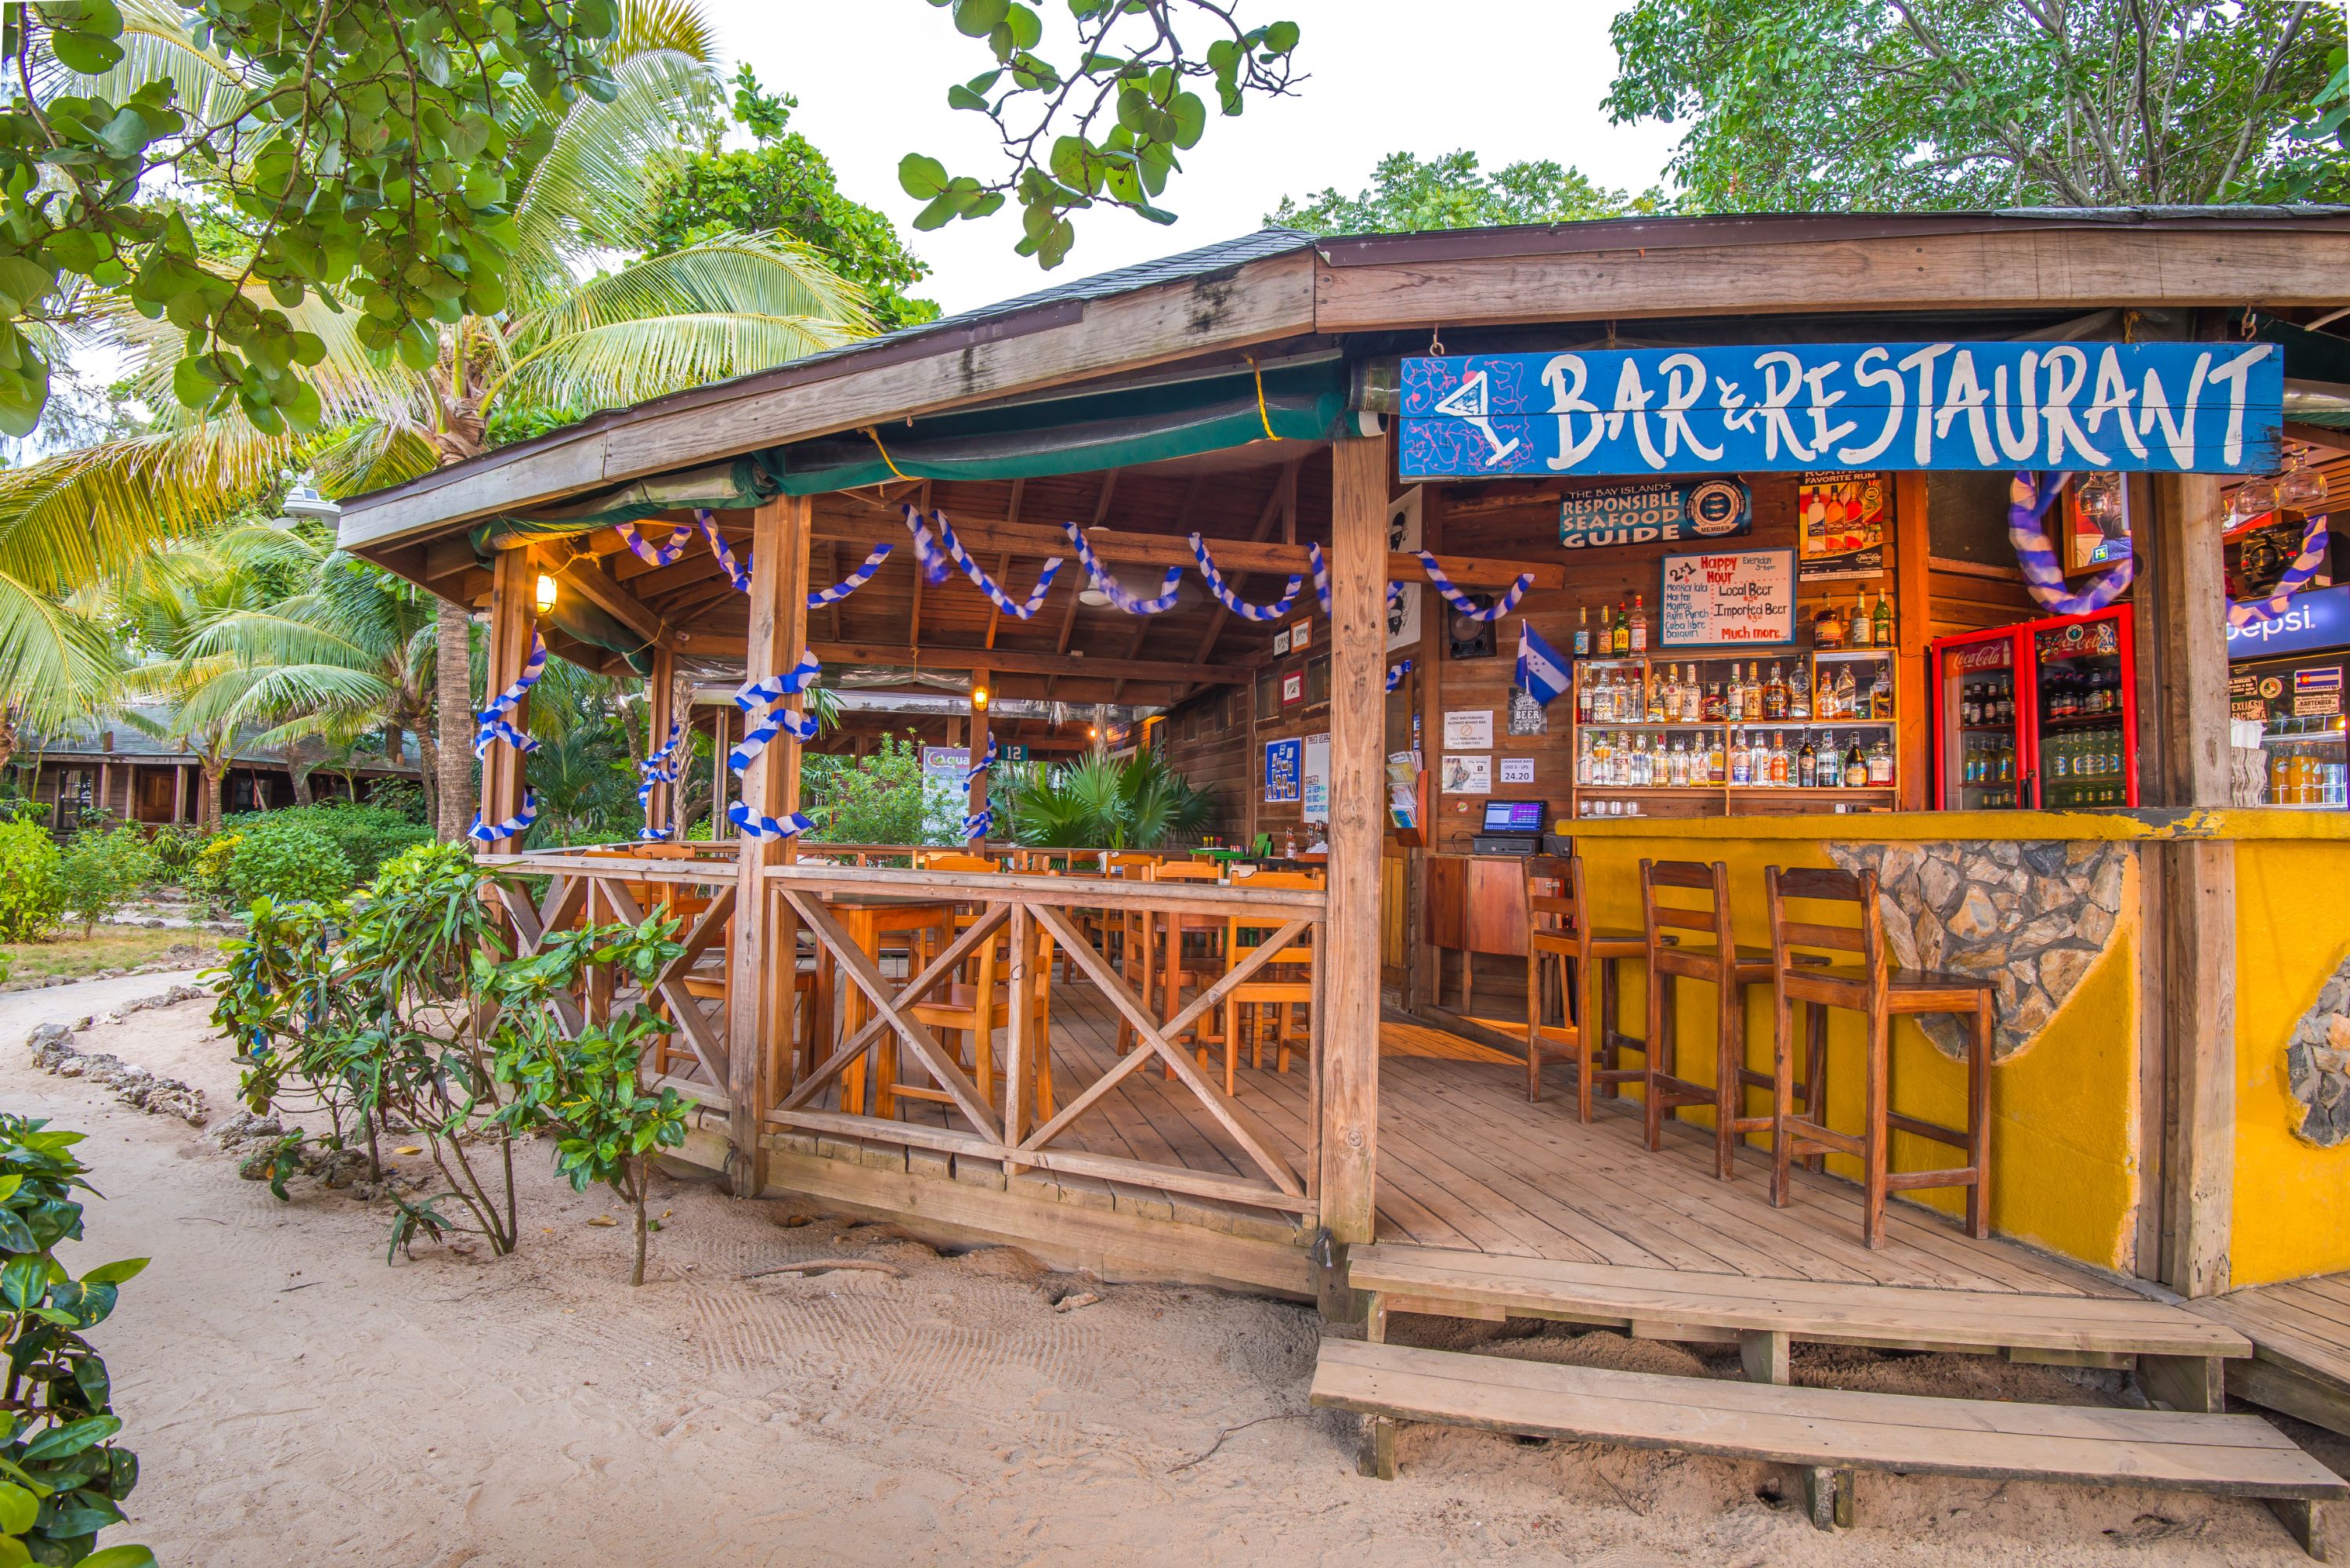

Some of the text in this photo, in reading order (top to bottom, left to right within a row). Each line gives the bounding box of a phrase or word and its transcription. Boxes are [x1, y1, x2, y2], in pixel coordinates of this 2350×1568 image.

[1542, 343, 2273, 471] BAR & RESTAURANT
[1805, 475, 1851, 484] FAVORITE
[1569, 482, 1672, 499] THE BAY ISLANDS
[1563, 491, 1680, 515] RESPONSIBLE
[1563, 509, 1680, 532] SEAFOOD
[1563, 525, 1680, 547] GUIDE
[1701, 556, 1737, 572] Happy
[1707, 571, 1734, 583] Hour
[1667, 583, 1692, 592] Monkey
[1719, 582, 1773, 596] Local Beer
[1666, 602, 1692, 612] Mojitos
[1666, 608, 1709, 620] Rum Punch
[1713, 602, 1788, 619] Imported Beer
[1665, 620, 1686, 630] Cuba
[1721, 626, 1750, 639] Much
[1954, 645, 2002, 670] Coca-Cola
[1516, 710, 1539, 720] BEER
[1007, 746, 1021, 760] 12
